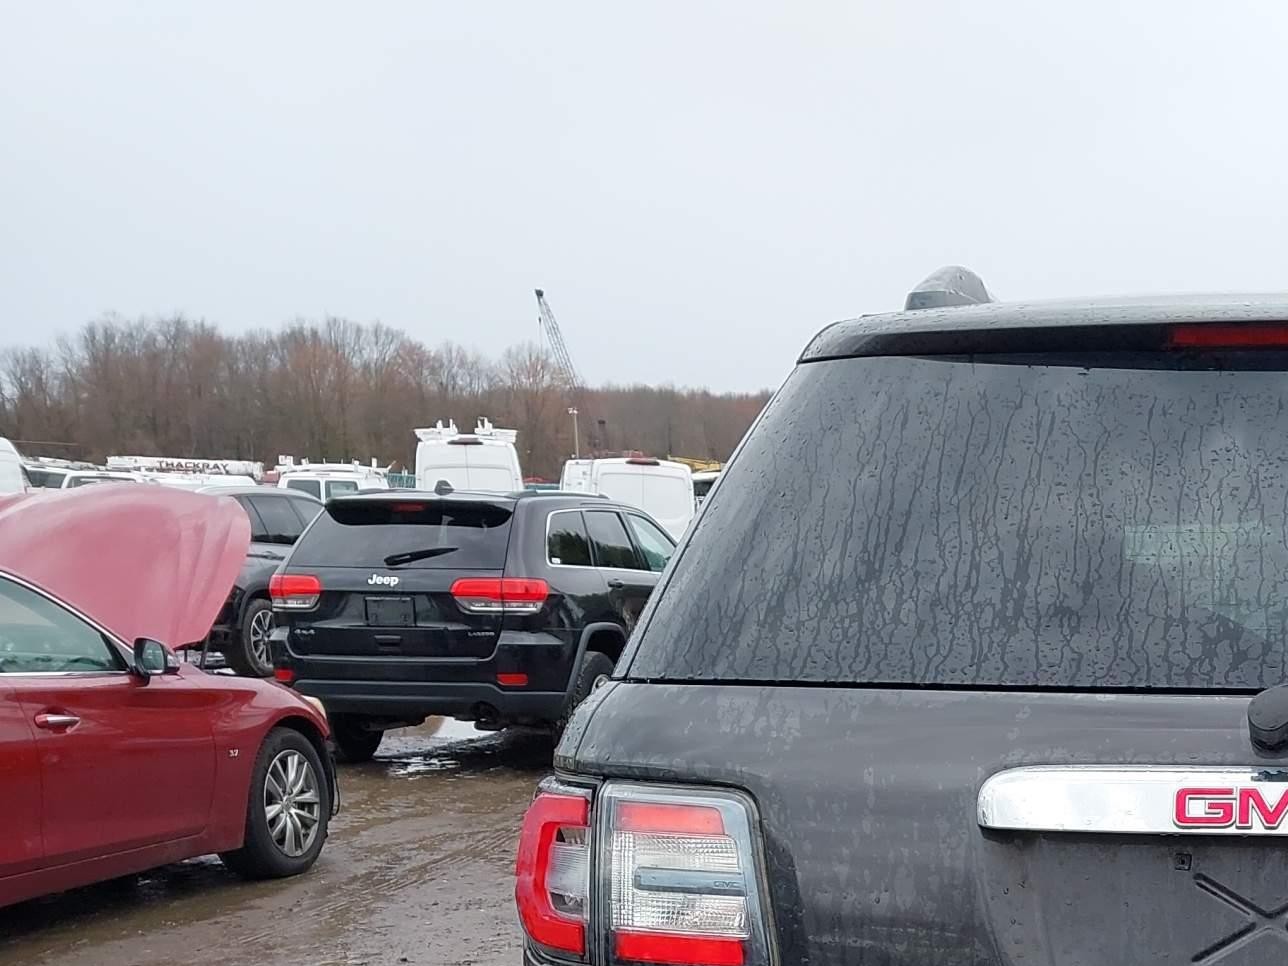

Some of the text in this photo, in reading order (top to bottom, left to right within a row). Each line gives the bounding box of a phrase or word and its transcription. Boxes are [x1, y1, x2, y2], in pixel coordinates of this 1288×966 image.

[157, 461, 229, 474] THACKRAY
[367, 574, 399, 587] Jeep
[712, 880, 742, 889] GMC
